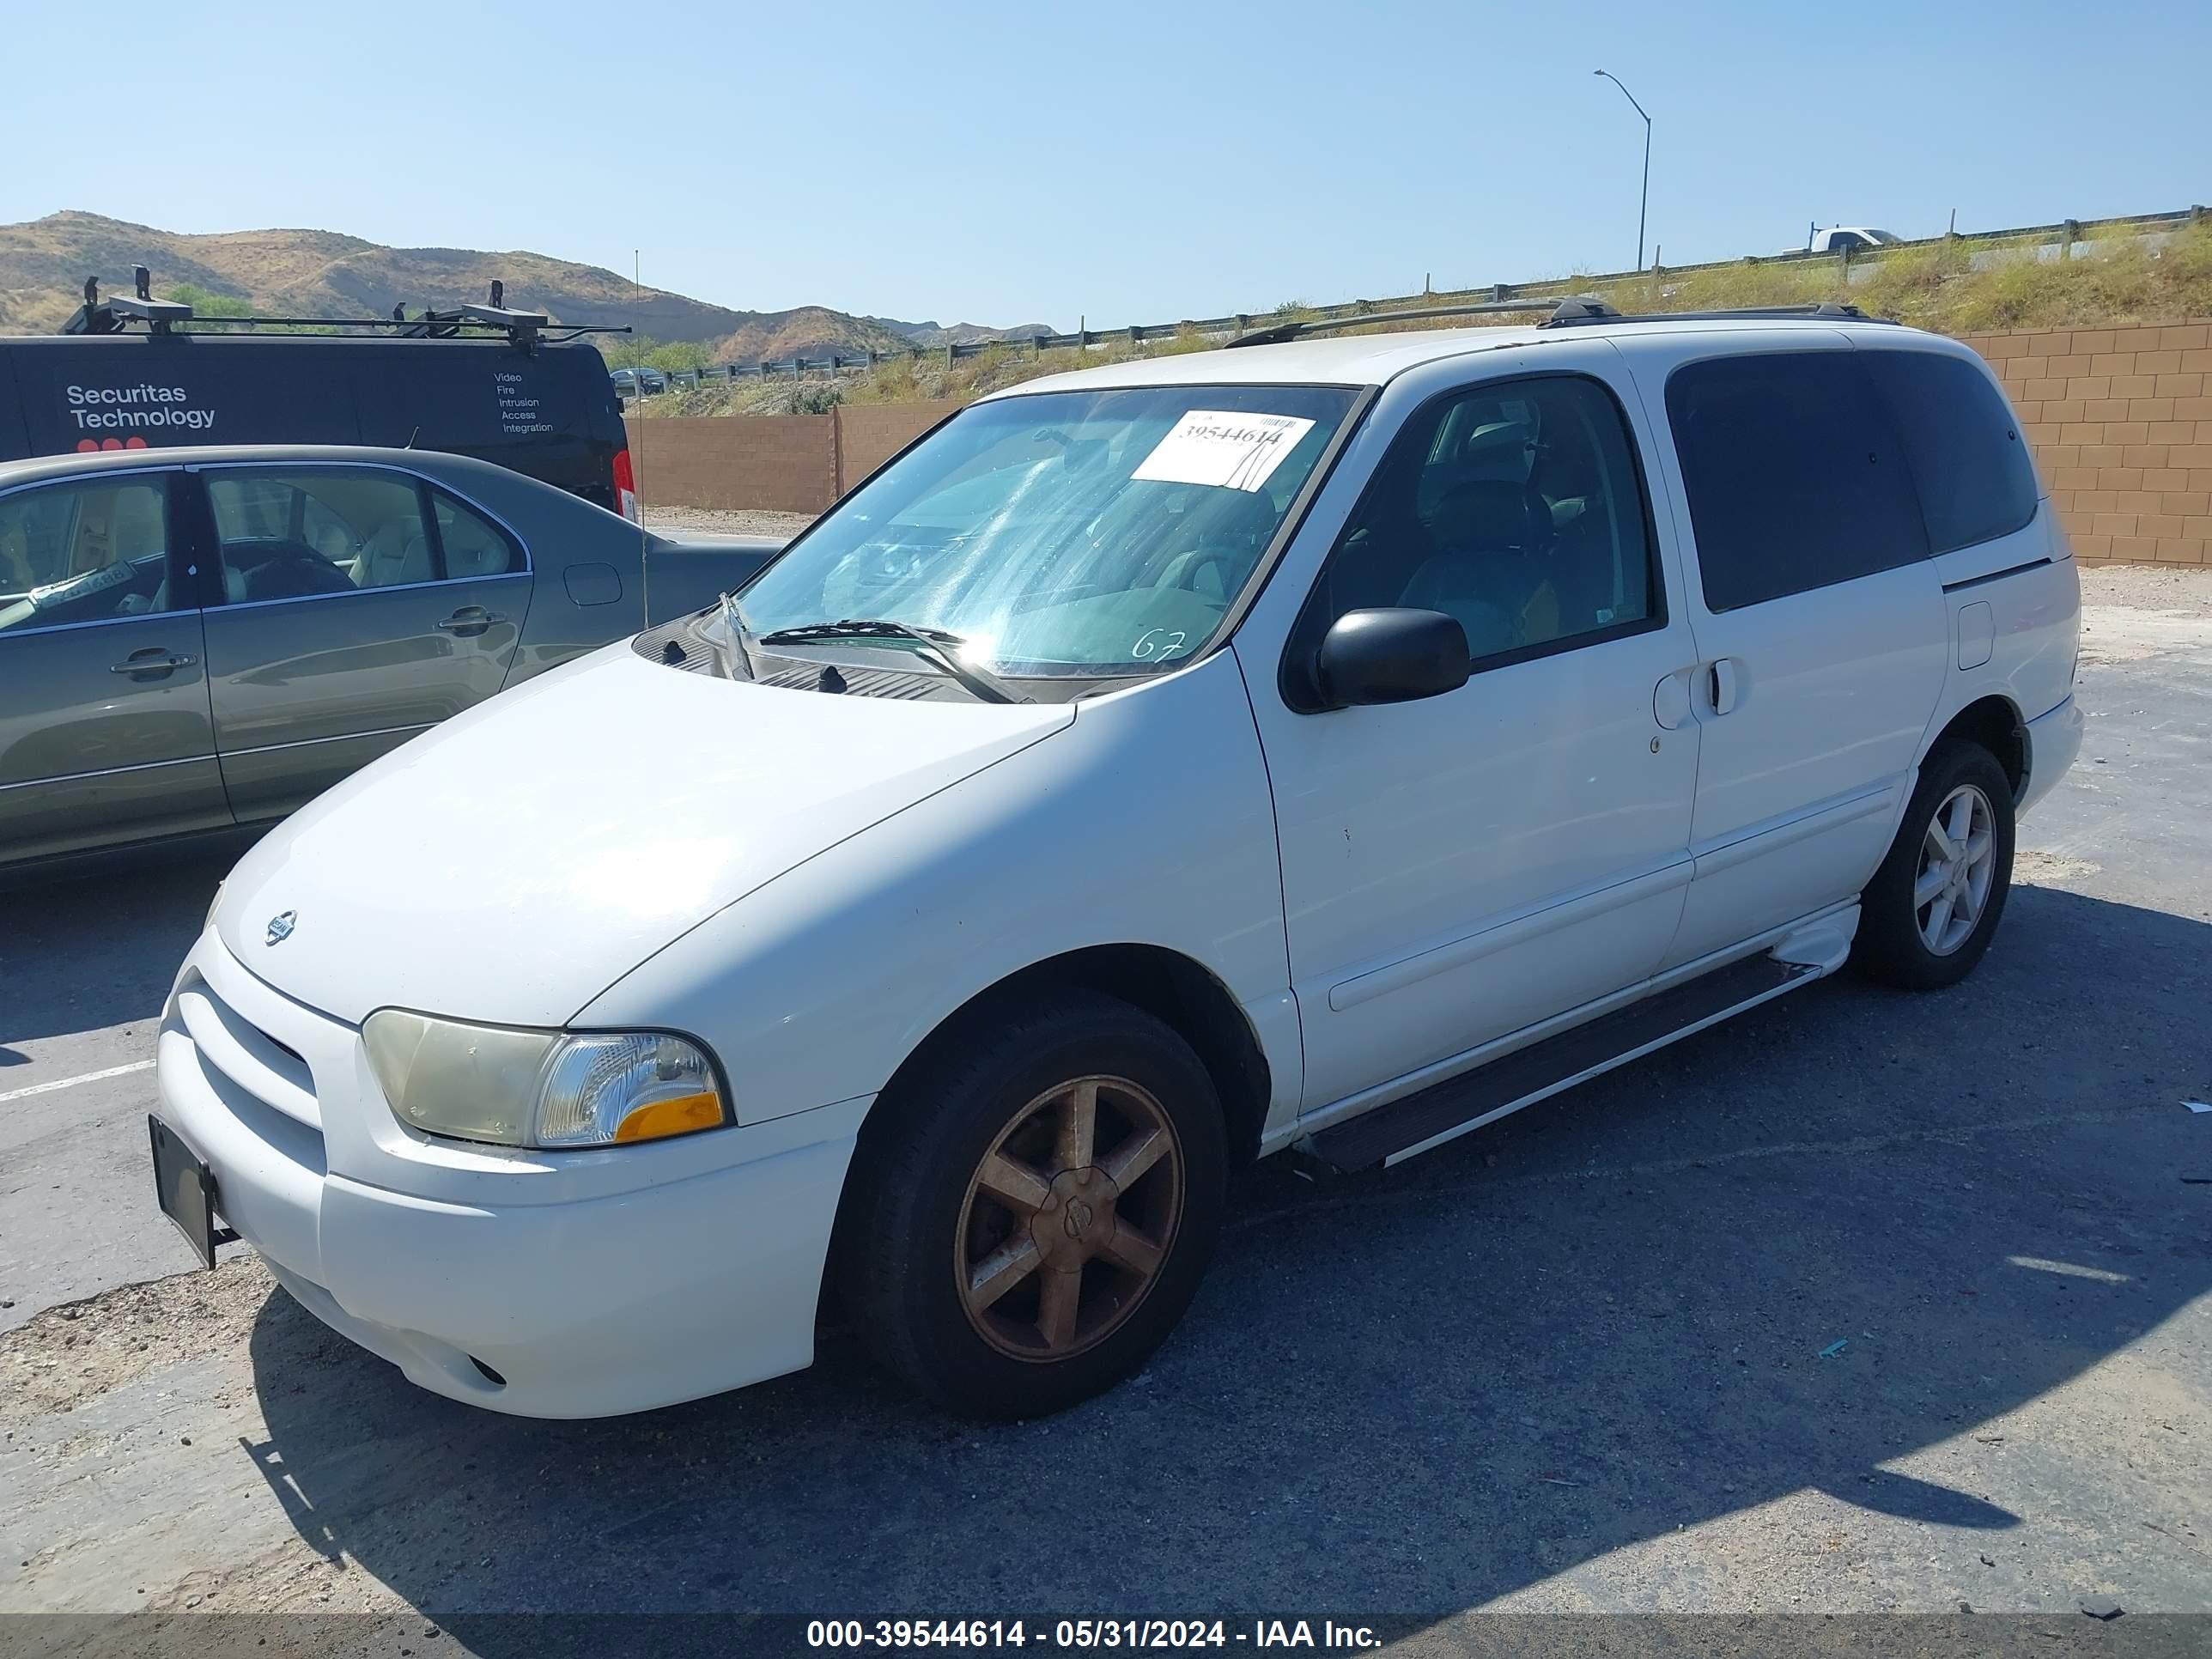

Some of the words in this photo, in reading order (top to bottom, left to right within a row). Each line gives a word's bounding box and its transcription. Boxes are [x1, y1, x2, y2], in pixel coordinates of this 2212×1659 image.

[494, 373, 522, 382] Video
[66, 383, 187, 404] Securitas
[496, 386, 515, 395] Fire
[499, 398, 539, 408] Intrusion
[70, 406, 216, 429] Technology
[501, 410, 537, 420] Access
[503, 422, 554, 434] Integration
[1179, 425, 1285, 445] 39544614
[1132, 628, 1186, 665] 67
